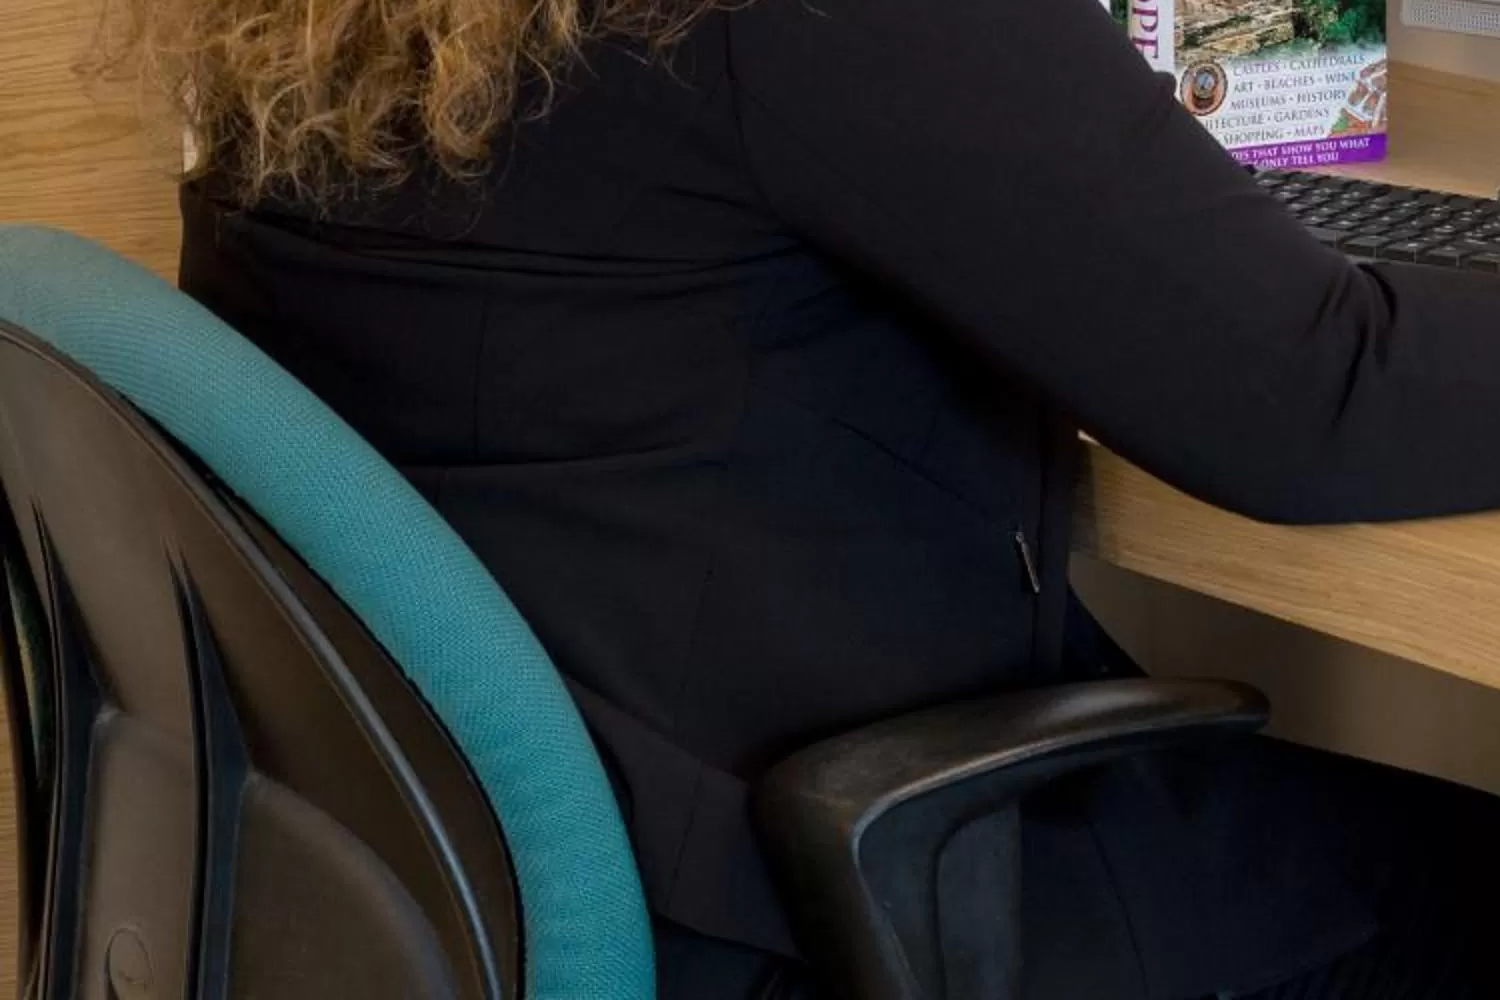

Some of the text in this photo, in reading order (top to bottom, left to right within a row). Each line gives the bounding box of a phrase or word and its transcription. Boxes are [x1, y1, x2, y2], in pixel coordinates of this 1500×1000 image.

[1233, 54, 1366, 77] CASTLES CATHEDRALS
[1234, 81, 1254, 93] ART
[1264, 75, 1316, 90] BEACHES
[1230, 90, 1348, 111] MUSEUMS HISTORY
[1274, 108, 1331, 124] GARDENS
[1223, 126, 1325, 146] SHOPPING MAPS
[1252, 146, 1279, 159] THAT
[1281, 143, 1312, 156] SHOW
[1315, 140, 1337, 151] YOU
[1339, 137, 1371, 150] WHAT
[1292, 154, 1314, 165] TELL
[1317, 151, 1339, 162] YOU
